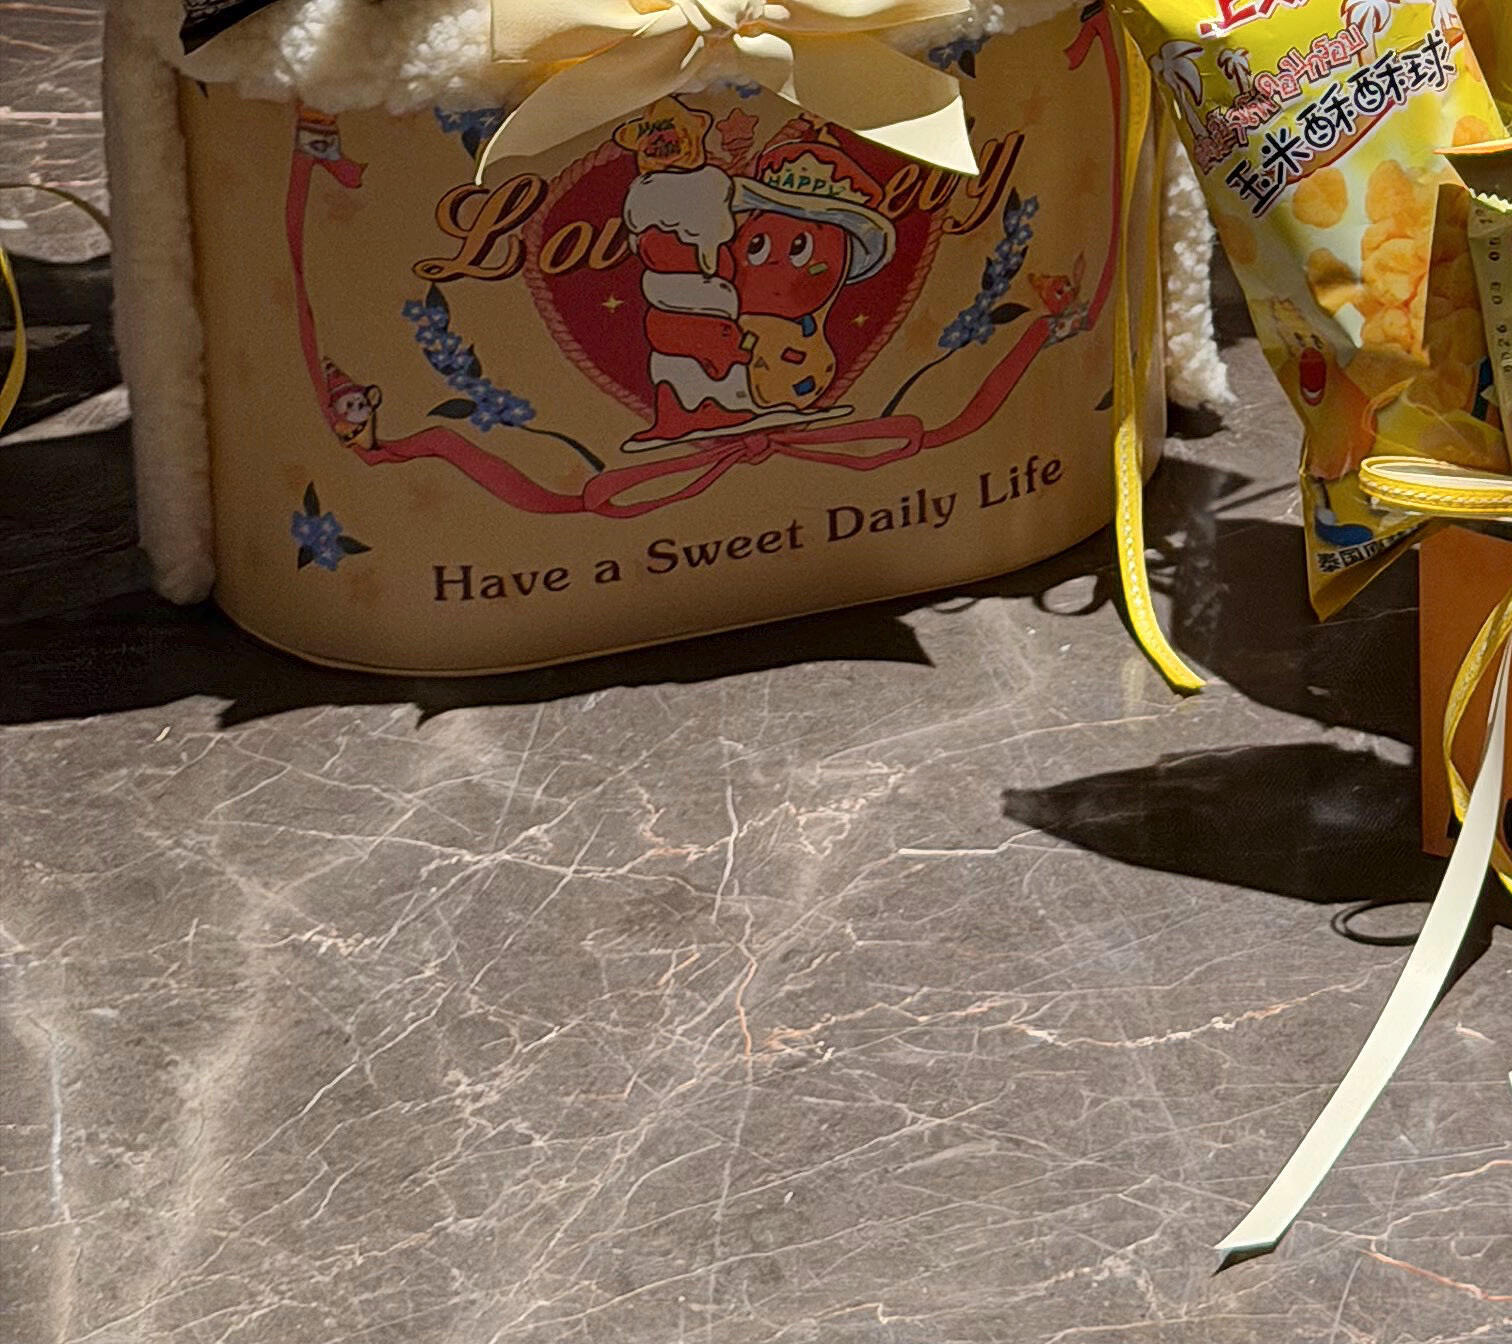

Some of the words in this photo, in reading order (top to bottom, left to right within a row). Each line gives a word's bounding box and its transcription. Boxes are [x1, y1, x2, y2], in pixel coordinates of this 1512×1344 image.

[1225, 28, 1455, 217] 玉米酥酥球
[432, 562, 572, 604] Have
[594, 554, 622, 585] a
[647, 517, 804, 576] Sweet
[826, 482, 958, 543] Daily
[978, 451, 1065, 507] Life
